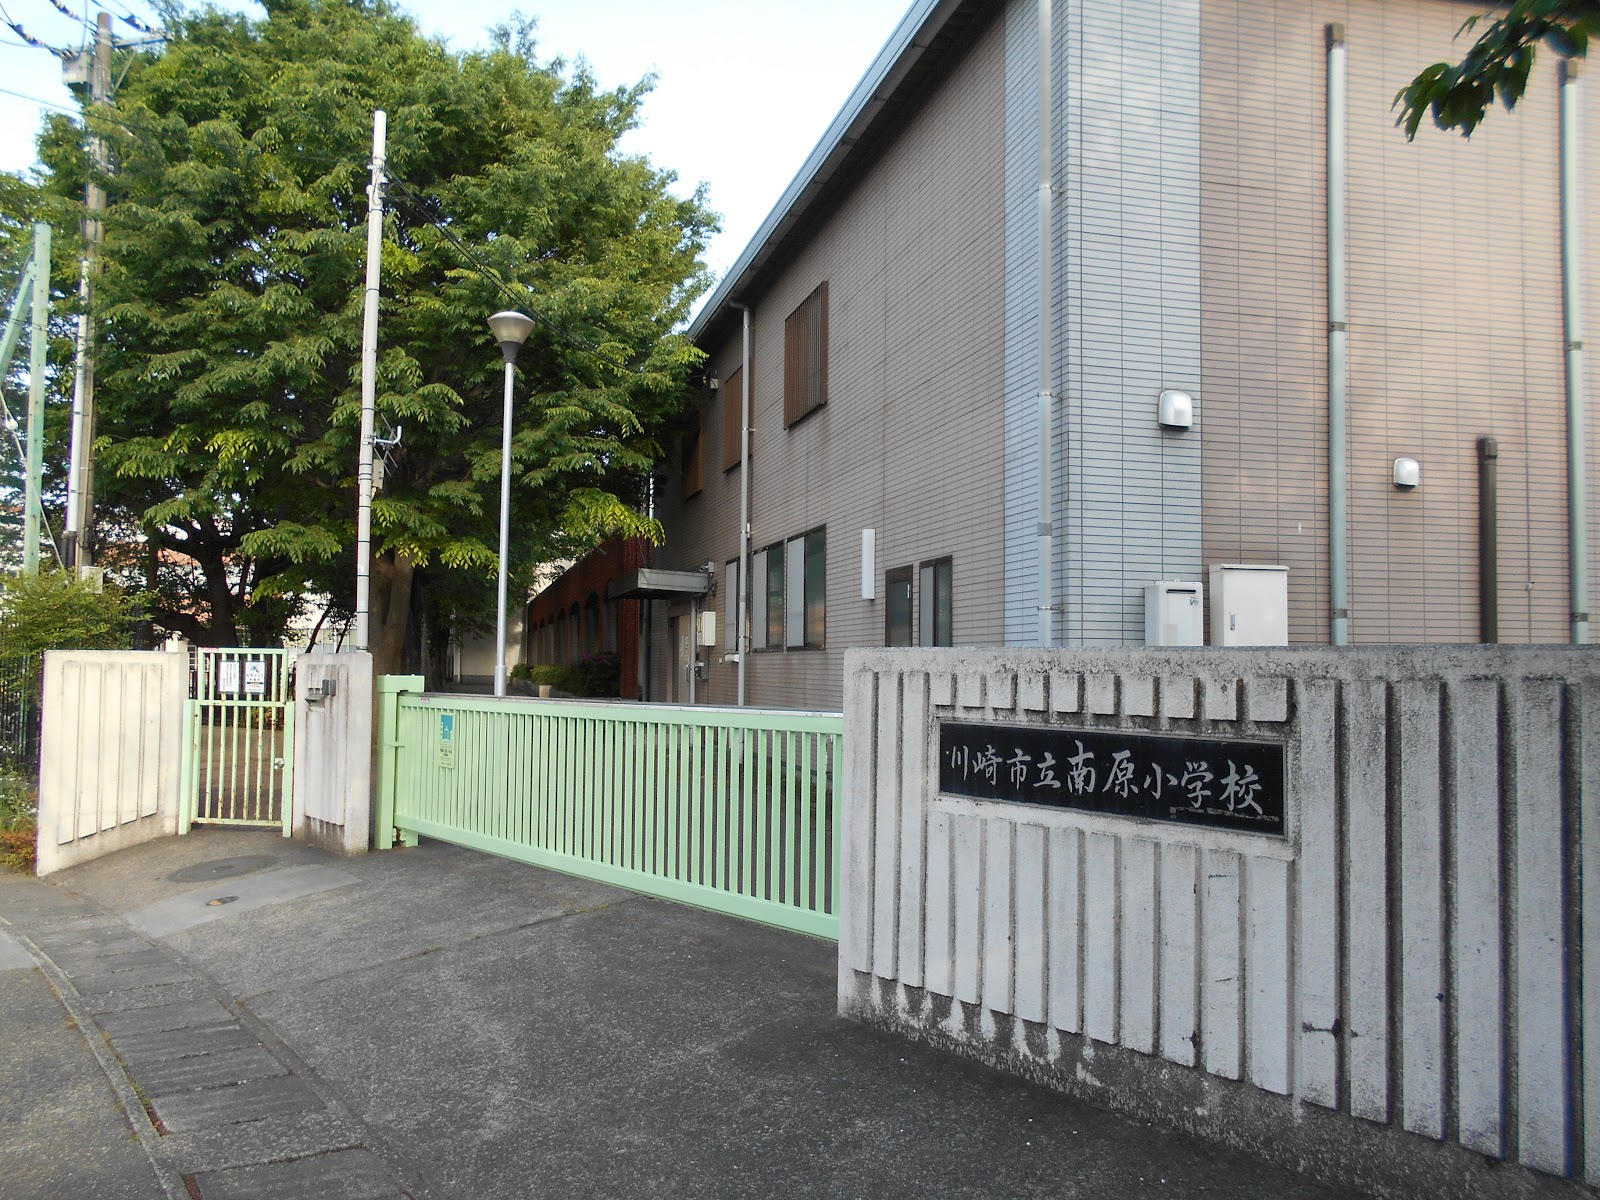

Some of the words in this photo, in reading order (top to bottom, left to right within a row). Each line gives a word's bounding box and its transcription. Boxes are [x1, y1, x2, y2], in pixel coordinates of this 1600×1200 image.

[950, 739, 1264, 815] 川崎市立南原小学校
